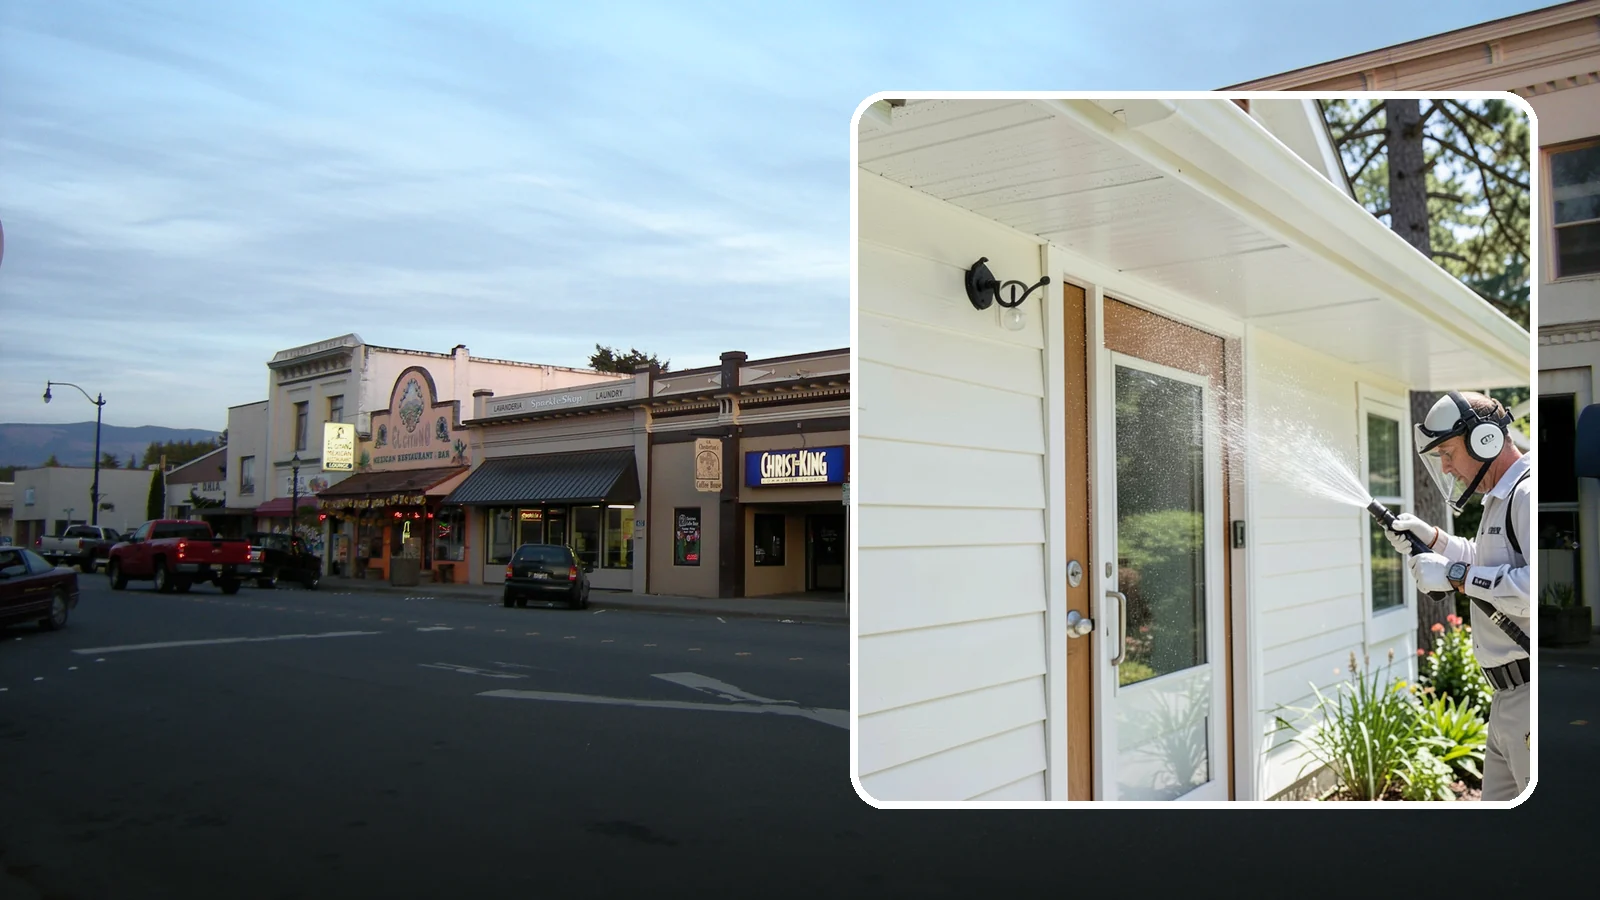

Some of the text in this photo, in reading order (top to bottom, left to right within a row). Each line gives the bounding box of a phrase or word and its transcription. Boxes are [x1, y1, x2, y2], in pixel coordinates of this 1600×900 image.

[530, 394, 582, 409] Sparkle Shop
[595, 389, 623, 400] LAUNDRY
[493, 402, 523, 413] LAVANDERIA
[373, 450, 450, 464] MEXICAN RESTAURANT BAR
[761, 450, 827, 478] CHRIST KING
